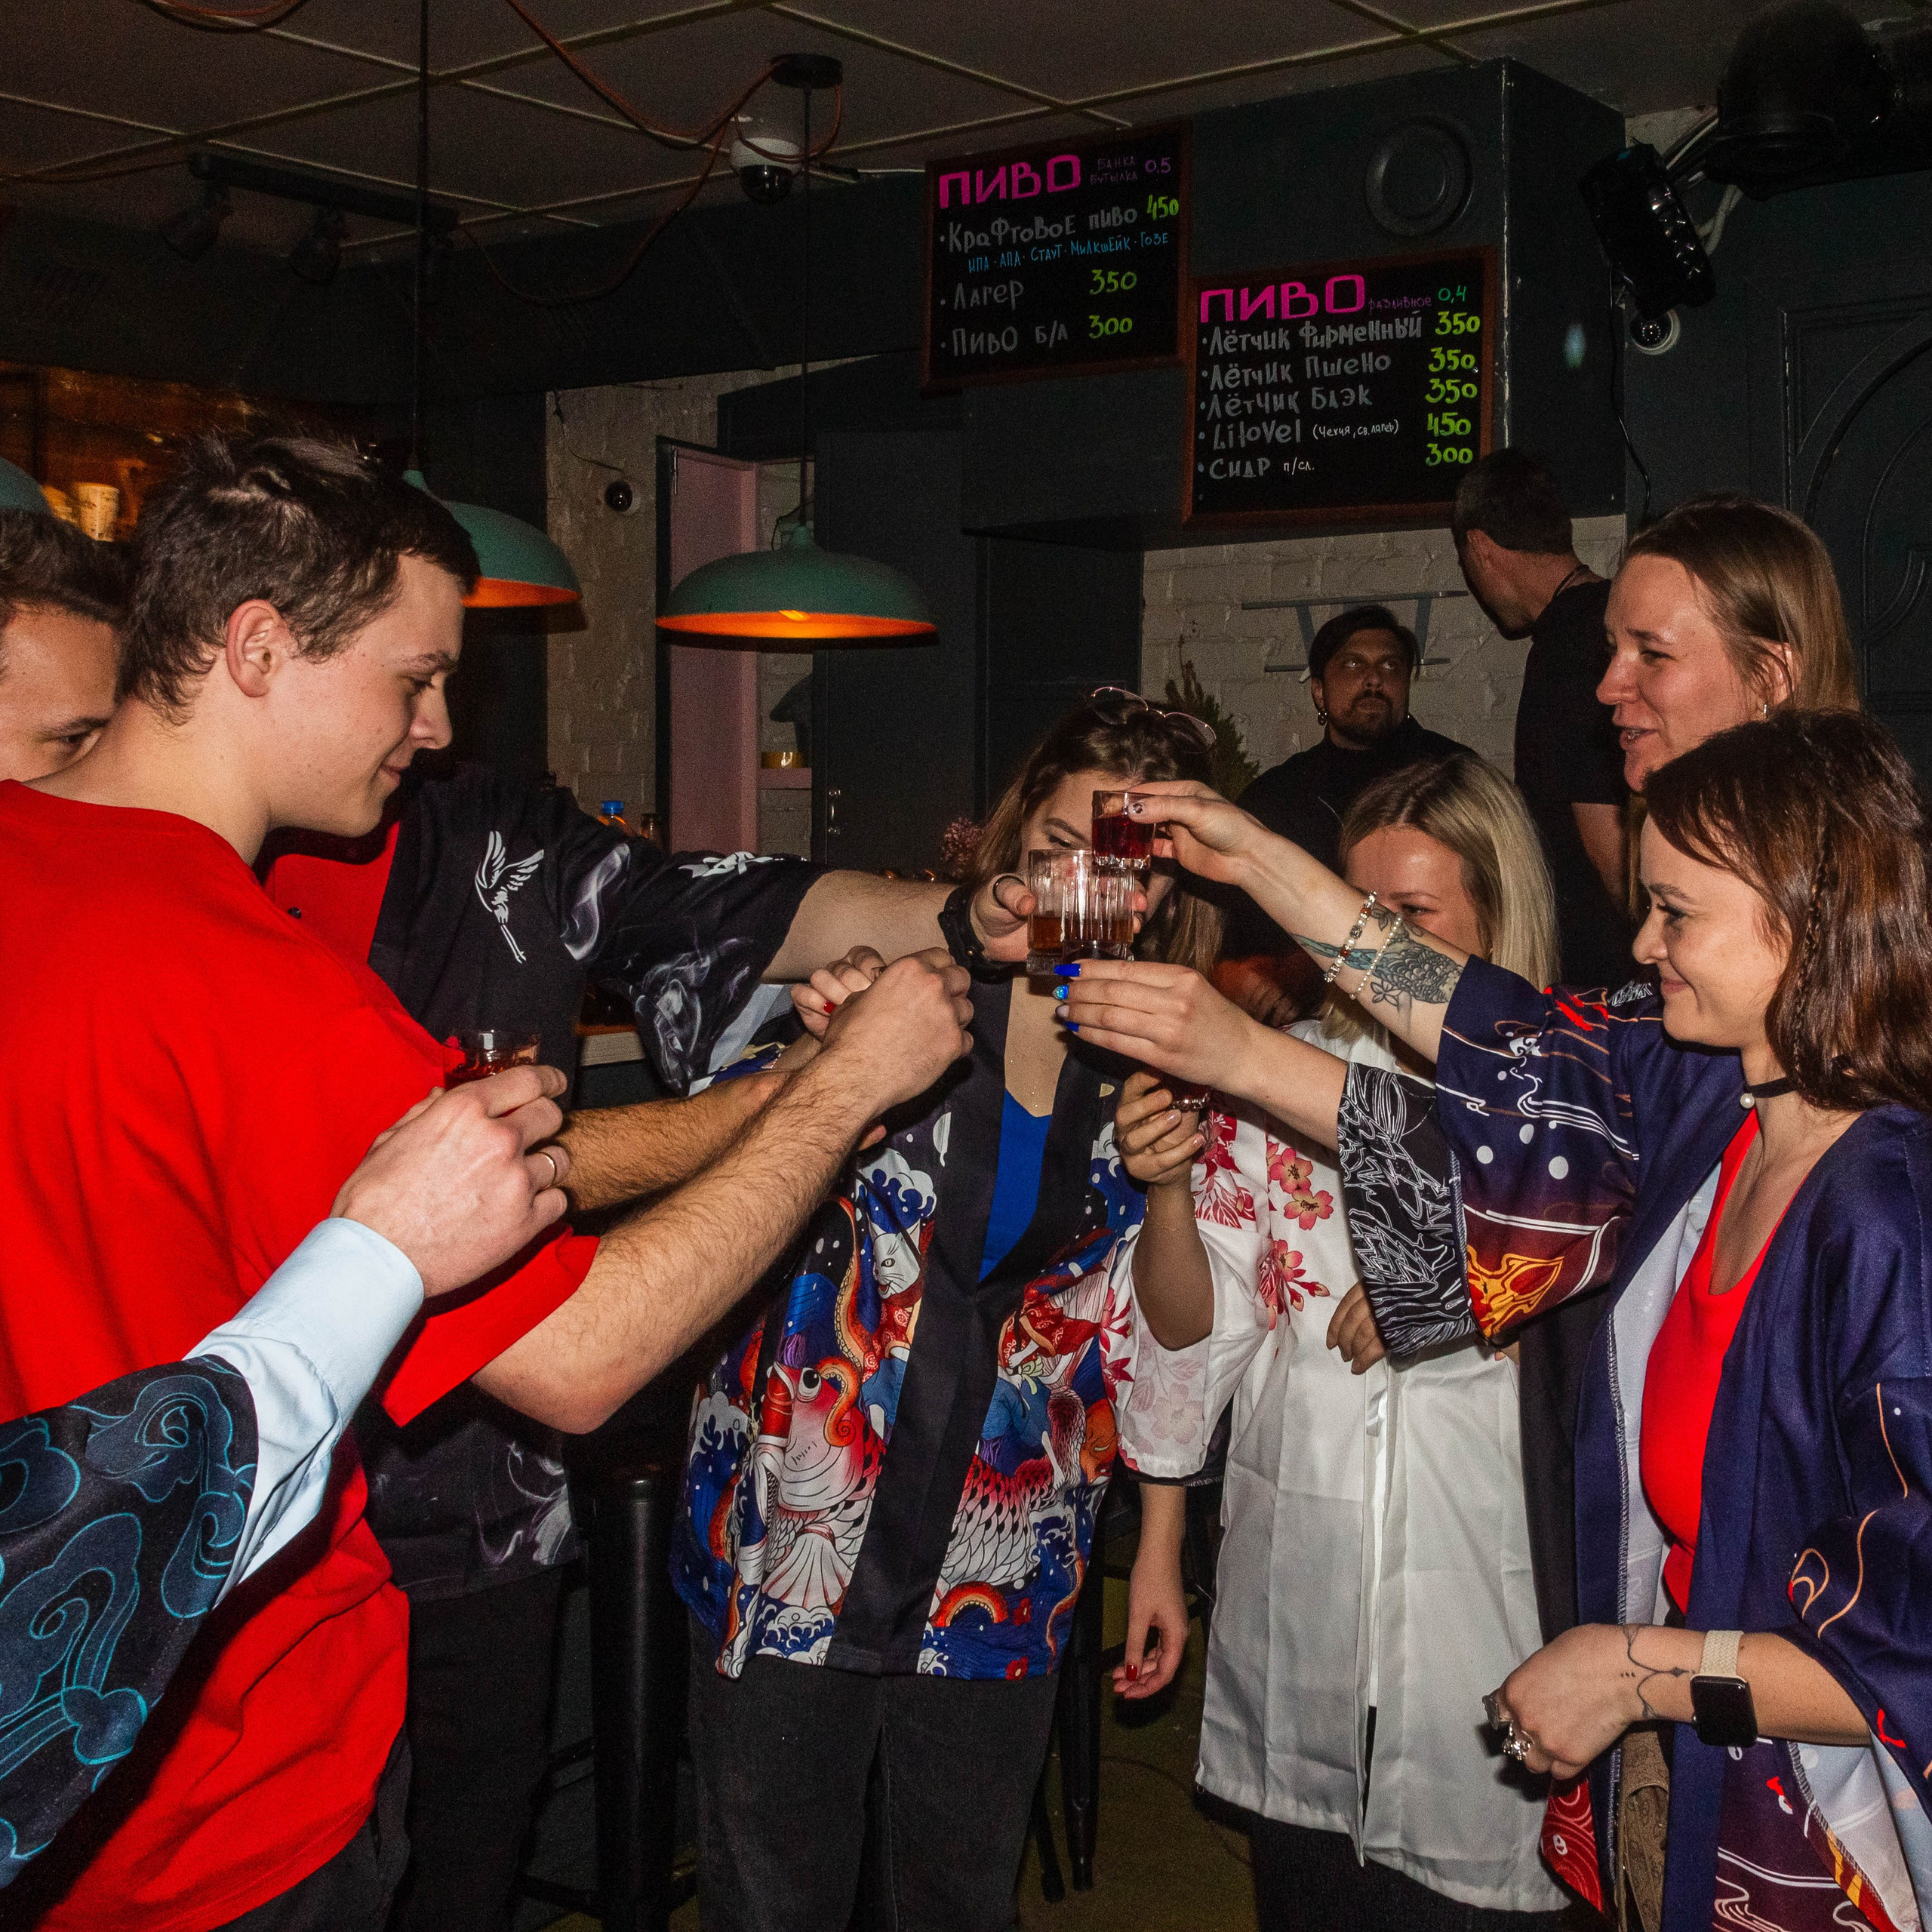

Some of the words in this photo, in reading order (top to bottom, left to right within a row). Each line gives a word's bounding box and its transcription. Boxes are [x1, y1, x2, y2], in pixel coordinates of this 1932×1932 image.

[939, 154, 1081, 209] ПИВО
[1147, 194, 1180, 221] 450
[968, 256, 989, 274] ИПА
[999, 251, 1021, 268] АПА
[1088, 269, 1137, 295] 350
[1200, 275, 1365, 323] ПИВО
[1437, 285, 1467, 303] 0,4
[1088, 315, 1133, 339] 300
[1435, 310, 1481, 335] 350
[1428, 346, 1475, 372] 350
[1425, 378, 1478, 404] 350
[1426, 412, 1472, 437] 450
[1425, 443, 1473, 466] 300
